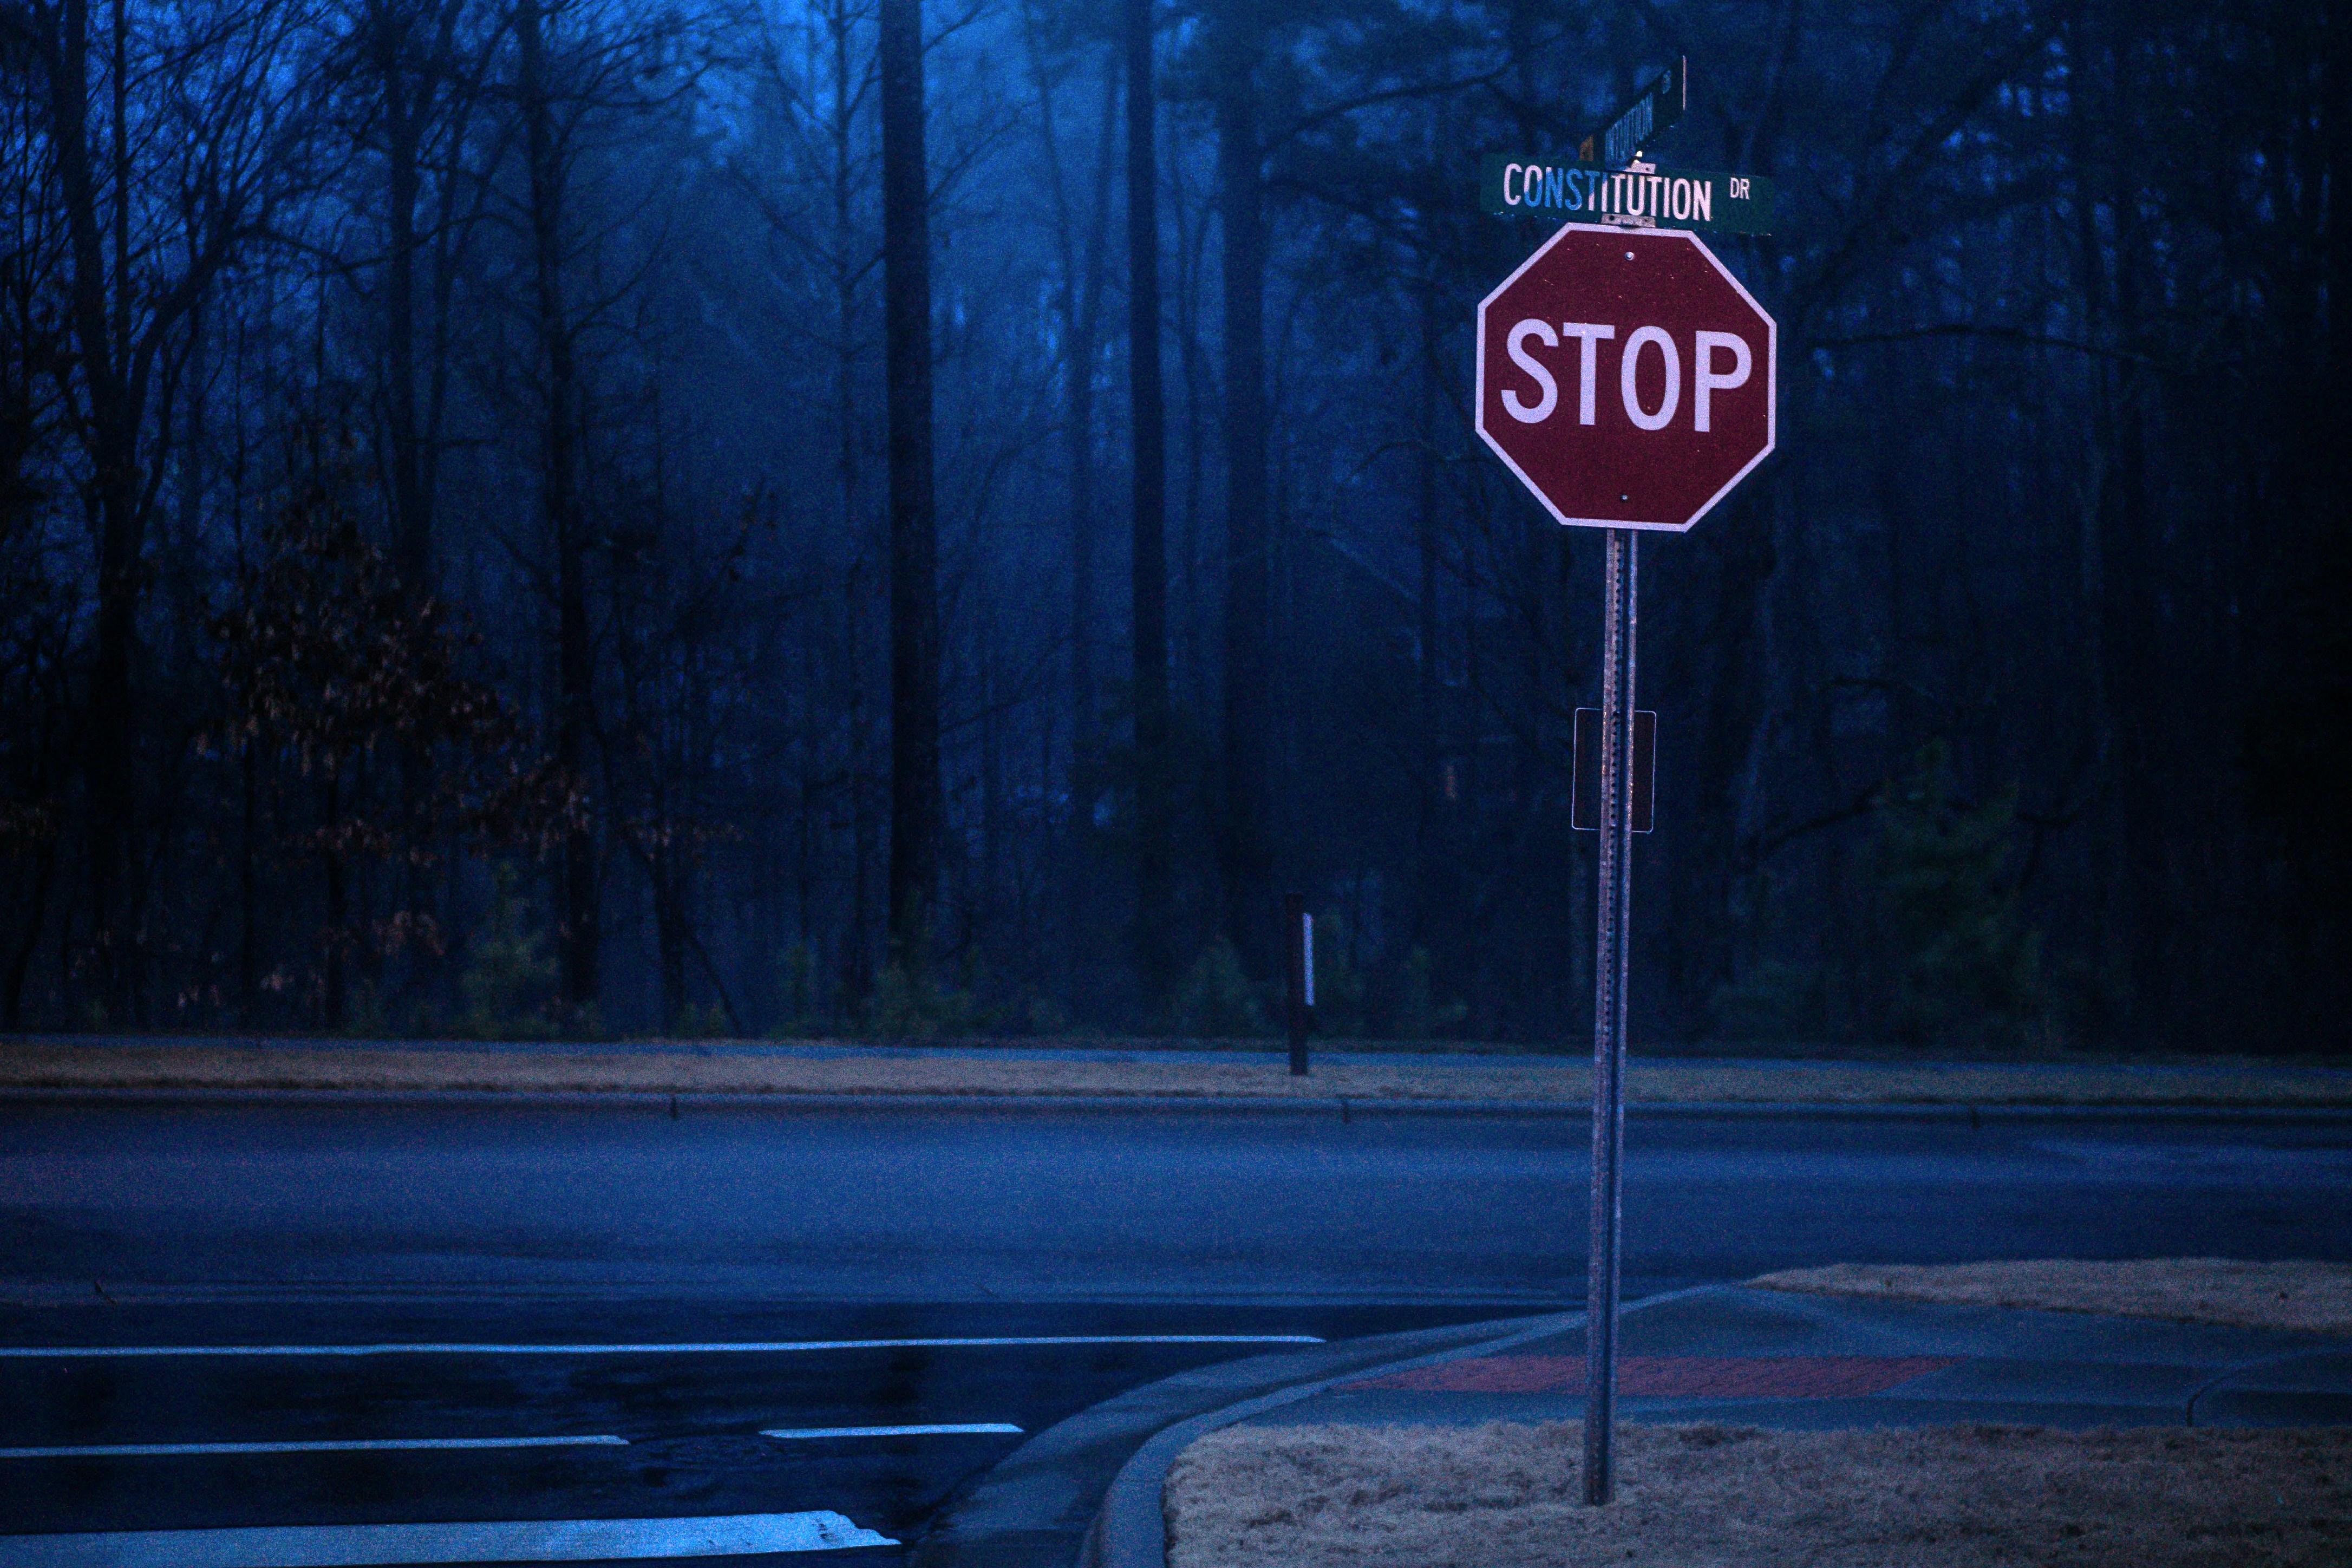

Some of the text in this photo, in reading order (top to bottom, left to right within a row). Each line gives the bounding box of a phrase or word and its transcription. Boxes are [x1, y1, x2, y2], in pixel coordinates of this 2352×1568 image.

[1503, 163, 1750, 221] CONSTITUTION DR
[1501, 318, 1752, 433] STOP
